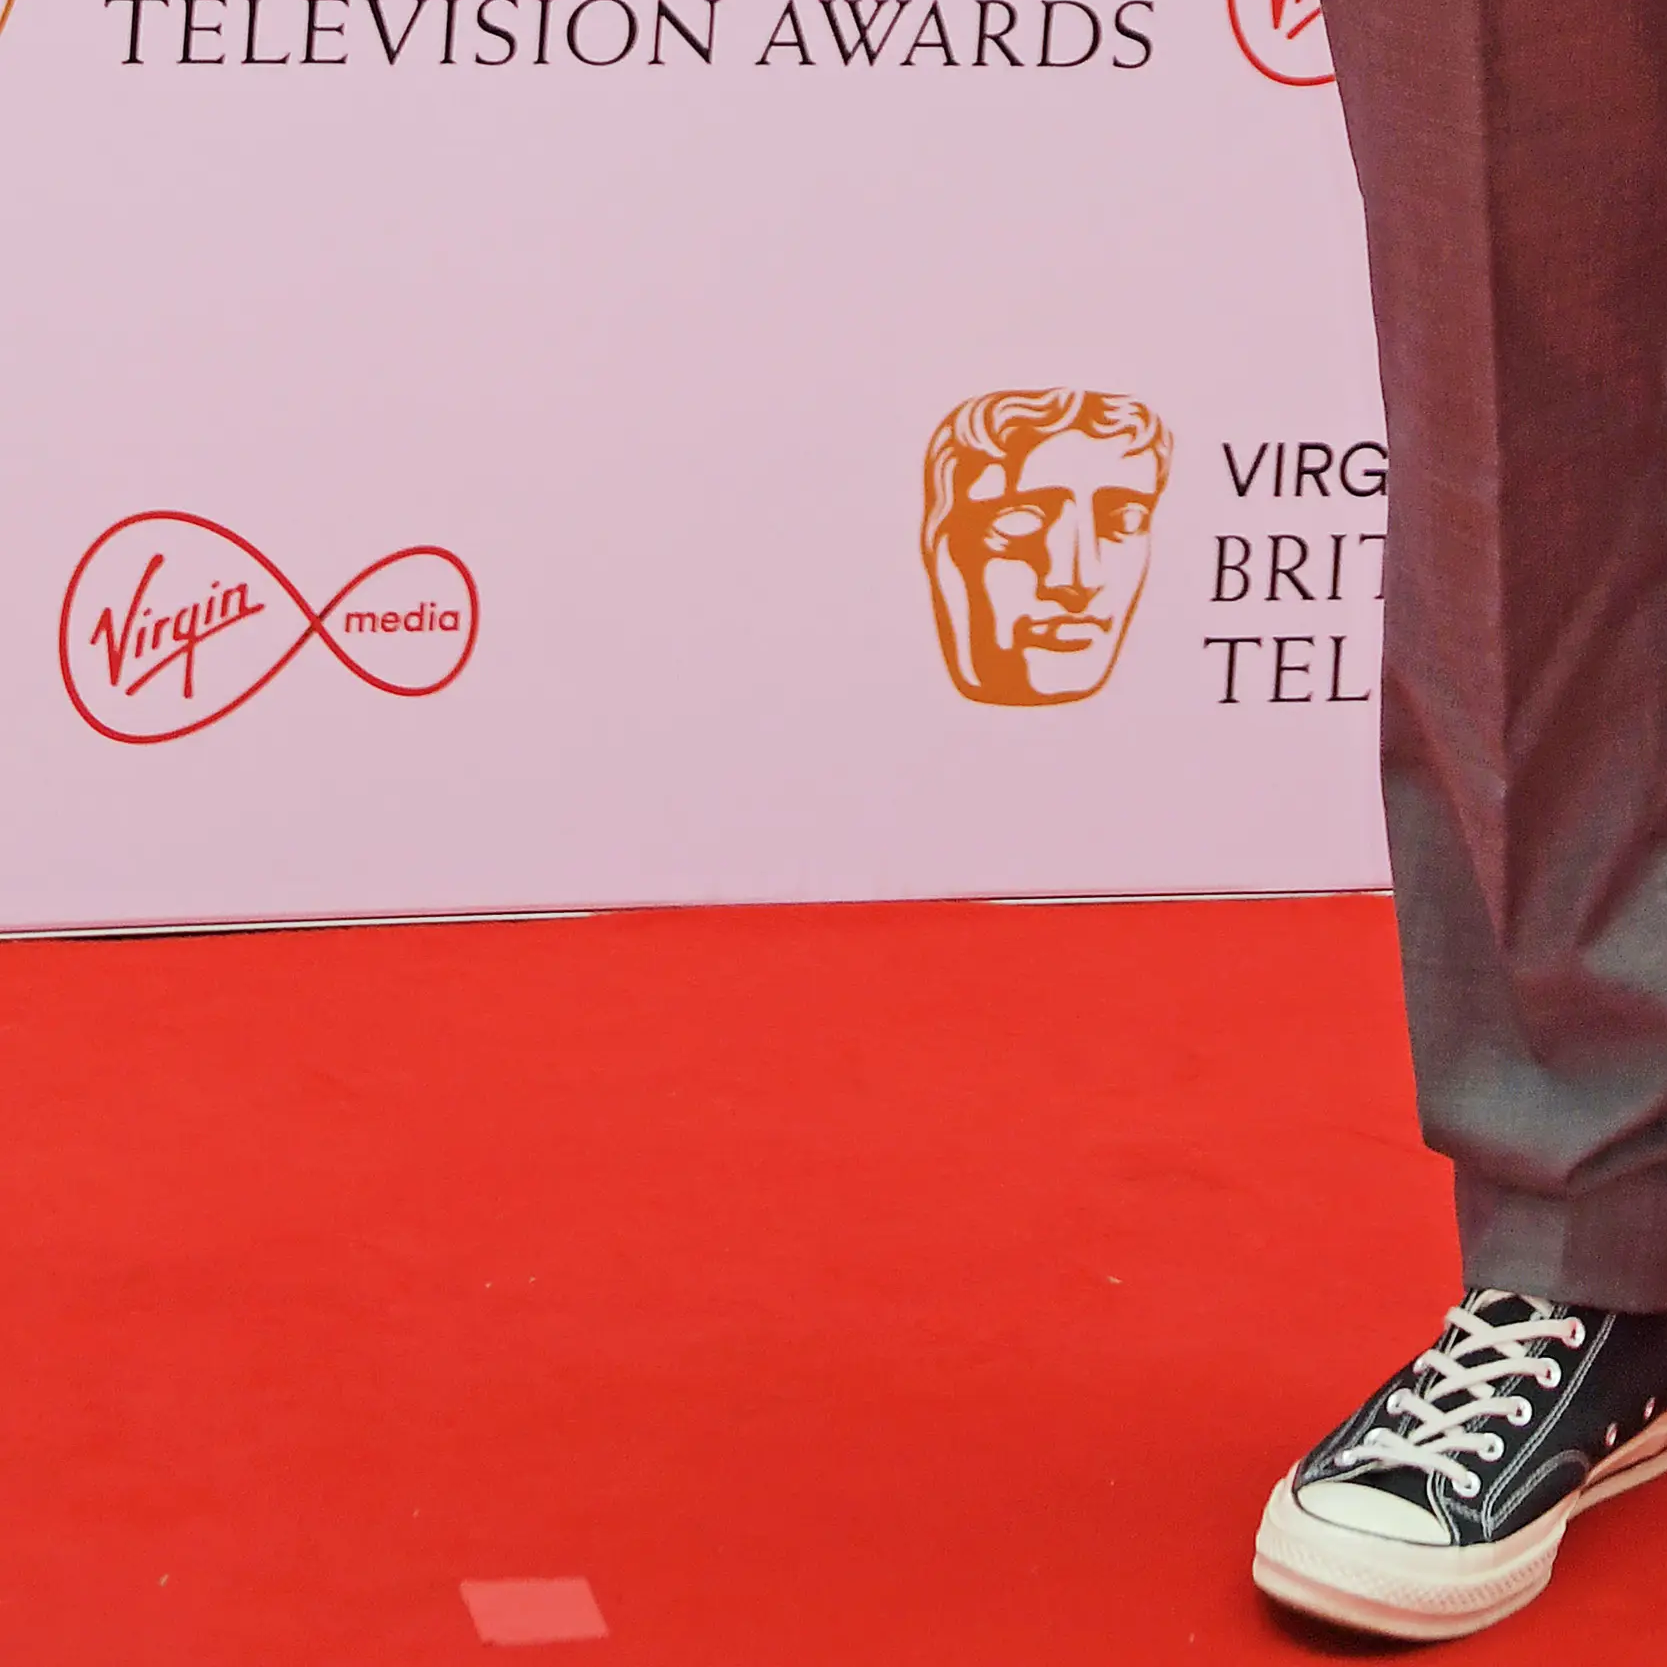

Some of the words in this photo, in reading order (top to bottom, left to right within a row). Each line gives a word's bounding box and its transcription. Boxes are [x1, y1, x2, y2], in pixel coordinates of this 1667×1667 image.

[1222, 441, 1388, 497] VIRG
[90, 553, 265, 699] Virgin
[345, 602, 460, 633] media
